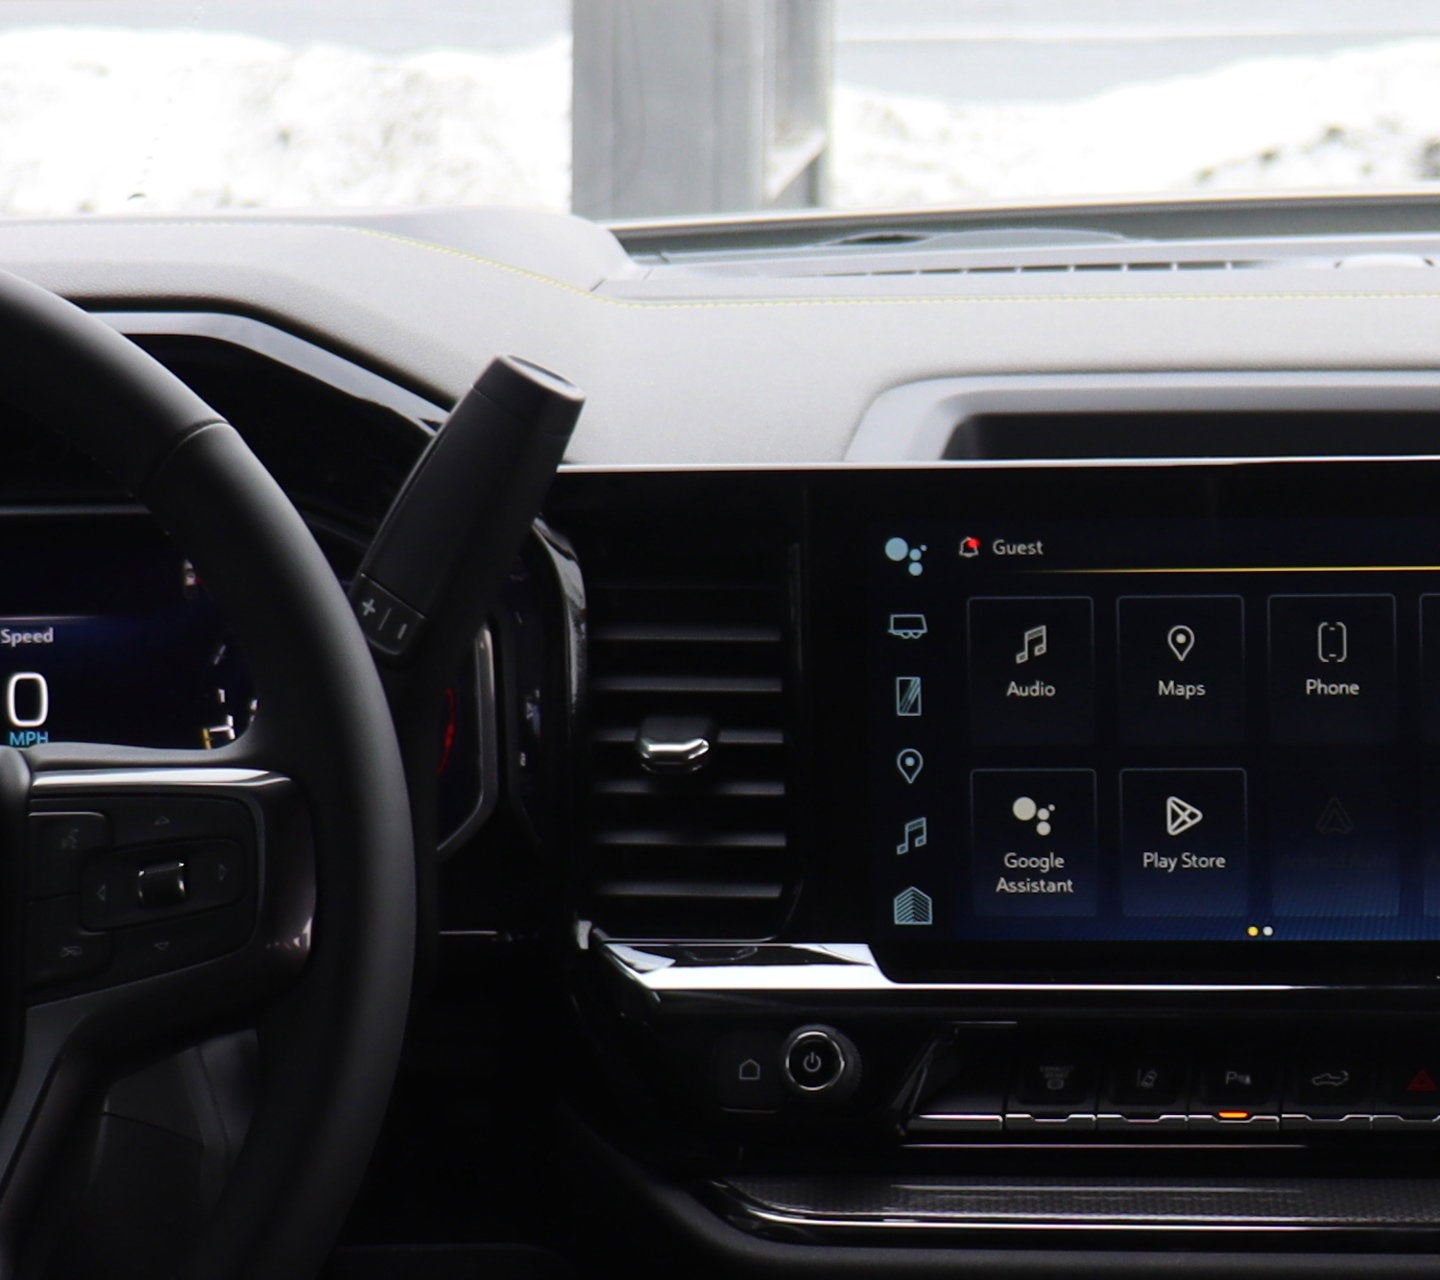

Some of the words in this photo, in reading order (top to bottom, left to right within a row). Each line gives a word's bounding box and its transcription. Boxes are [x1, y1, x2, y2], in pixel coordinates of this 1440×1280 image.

[991, 538, 1044, 557] Guest
[0, 627, 54, 648] Speed
[1006, 680, 1057, 699] Audio
[1158, 680, 1206, 701] Maps
[1305, 677, 1360, 696] Phone
[6, 672, 49, 728] 0
[8, 730, 50, 747] MPH
[1003, 852, 1065, 874] Google
[1142, 852, 1178, 874] Play
[1181, 852, 1226, 870] Store
[996, 876, 1074, 895] Assistant
